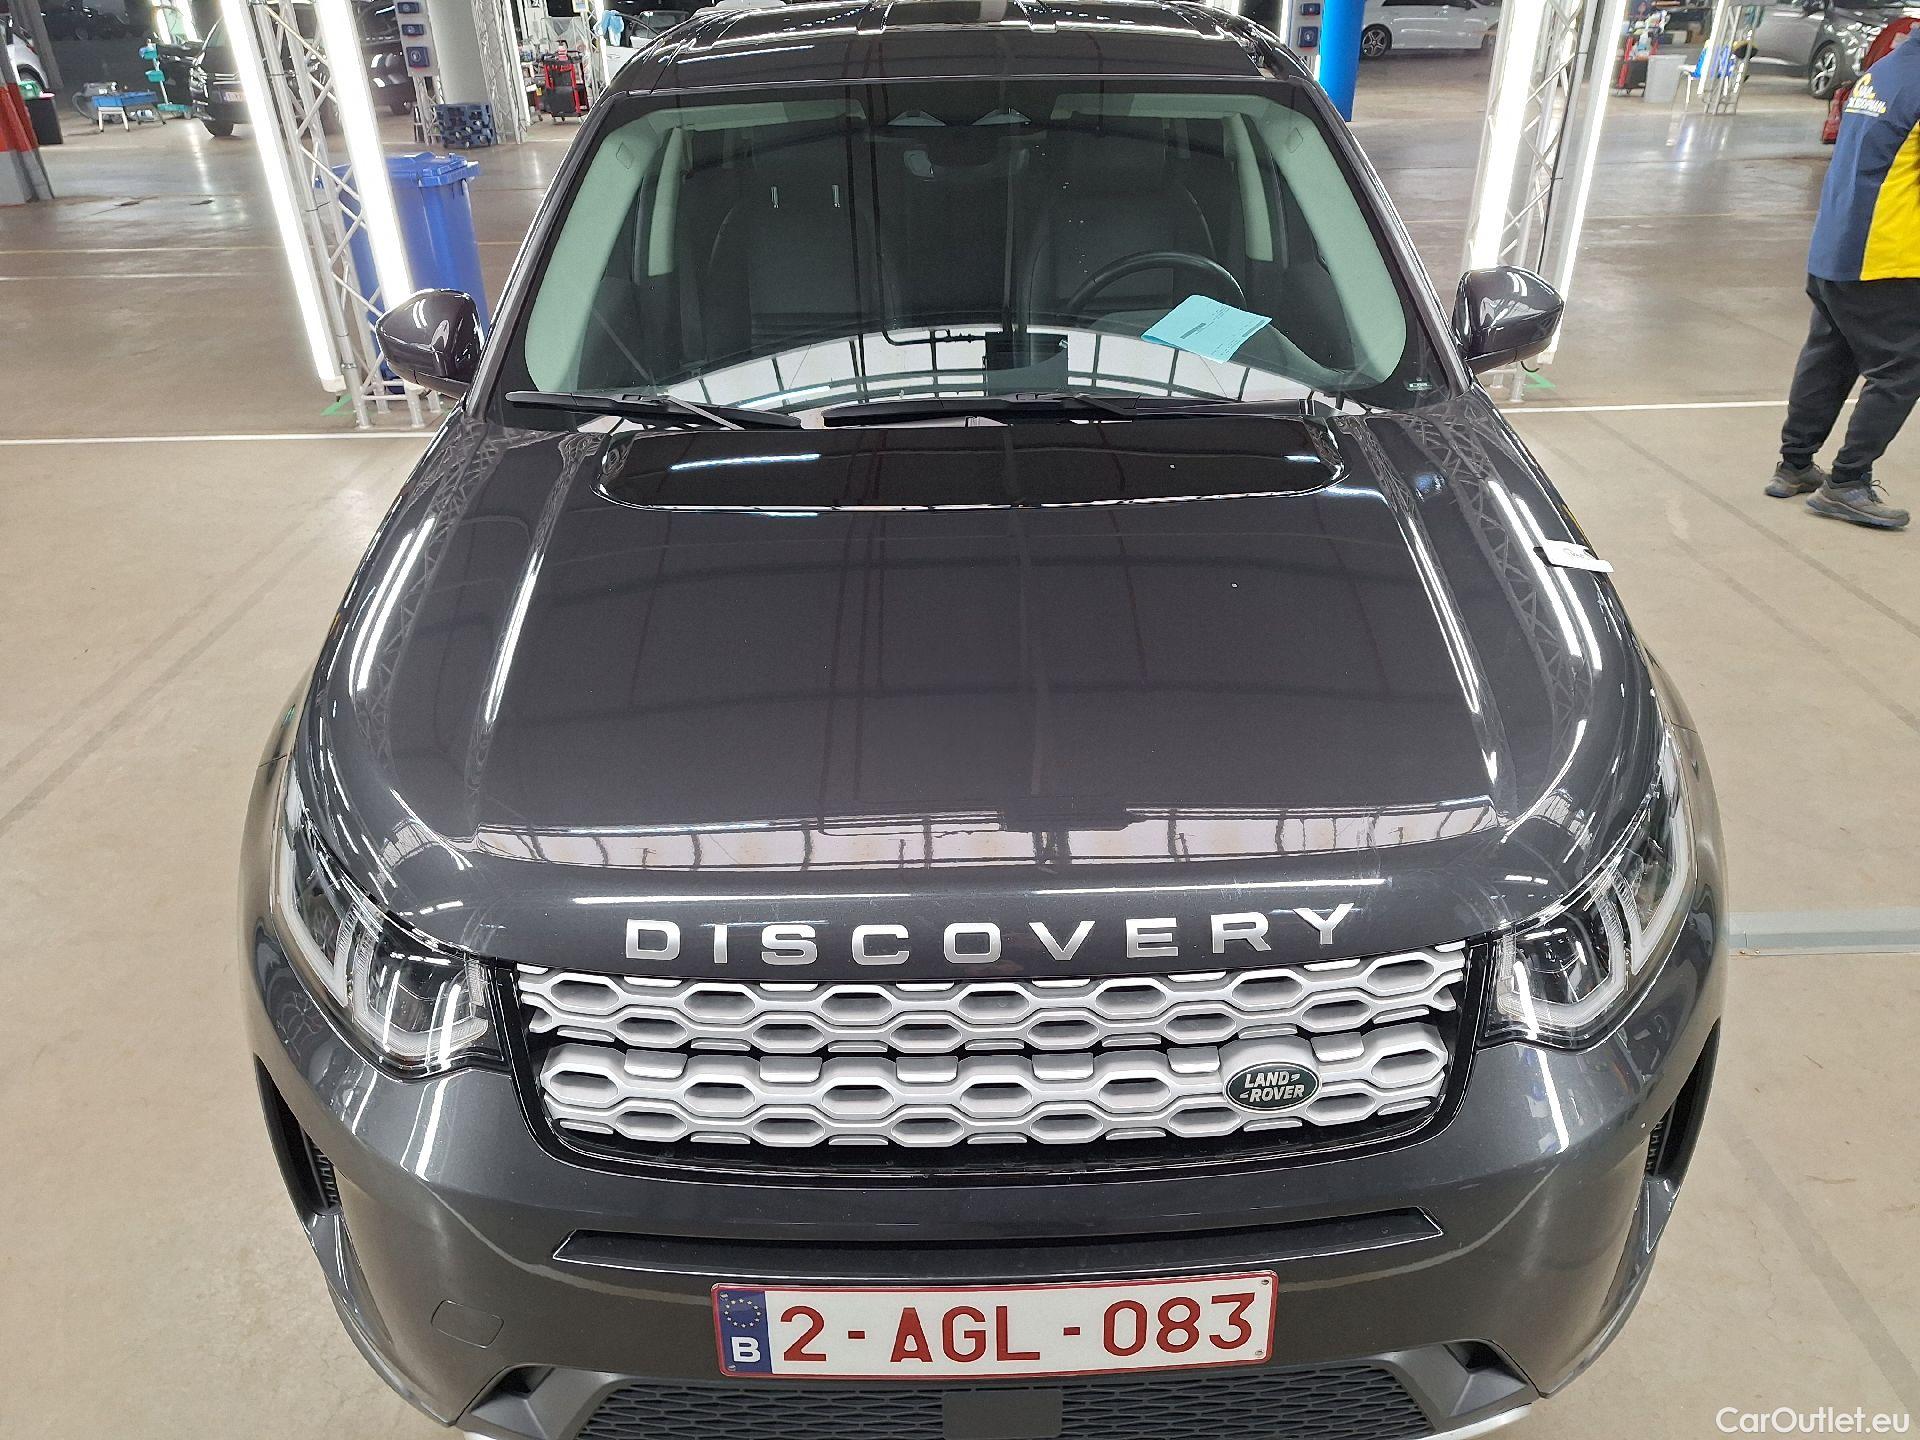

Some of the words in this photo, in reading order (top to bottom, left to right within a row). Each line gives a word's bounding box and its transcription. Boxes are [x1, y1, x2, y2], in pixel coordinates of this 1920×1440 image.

[626, 903, 1354, 965] DISCOVERY
[1245, 1071, 1289, 1088] LAND
[1249, 1084, 1304, 1102] ROVER
[731, 1336, 761, 1363] B
